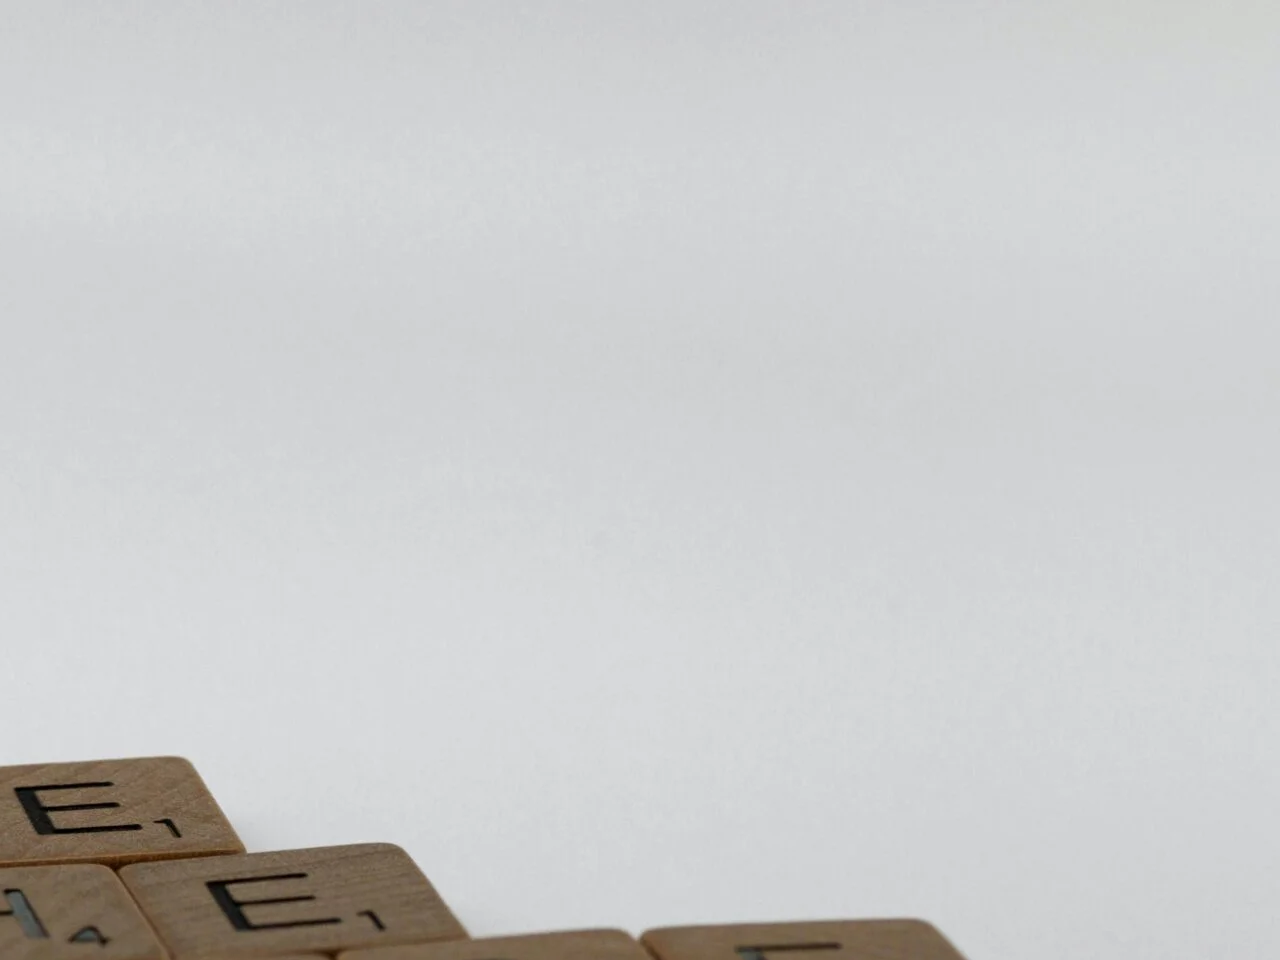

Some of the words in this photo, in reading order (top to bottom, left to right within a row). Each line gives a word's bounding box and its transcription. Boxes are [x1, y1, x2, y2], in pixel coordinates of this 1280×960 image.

[153, 817, 184, 840] 1
[357, 908, 387, 933] 1
[66, 924, 110, 947] 4
